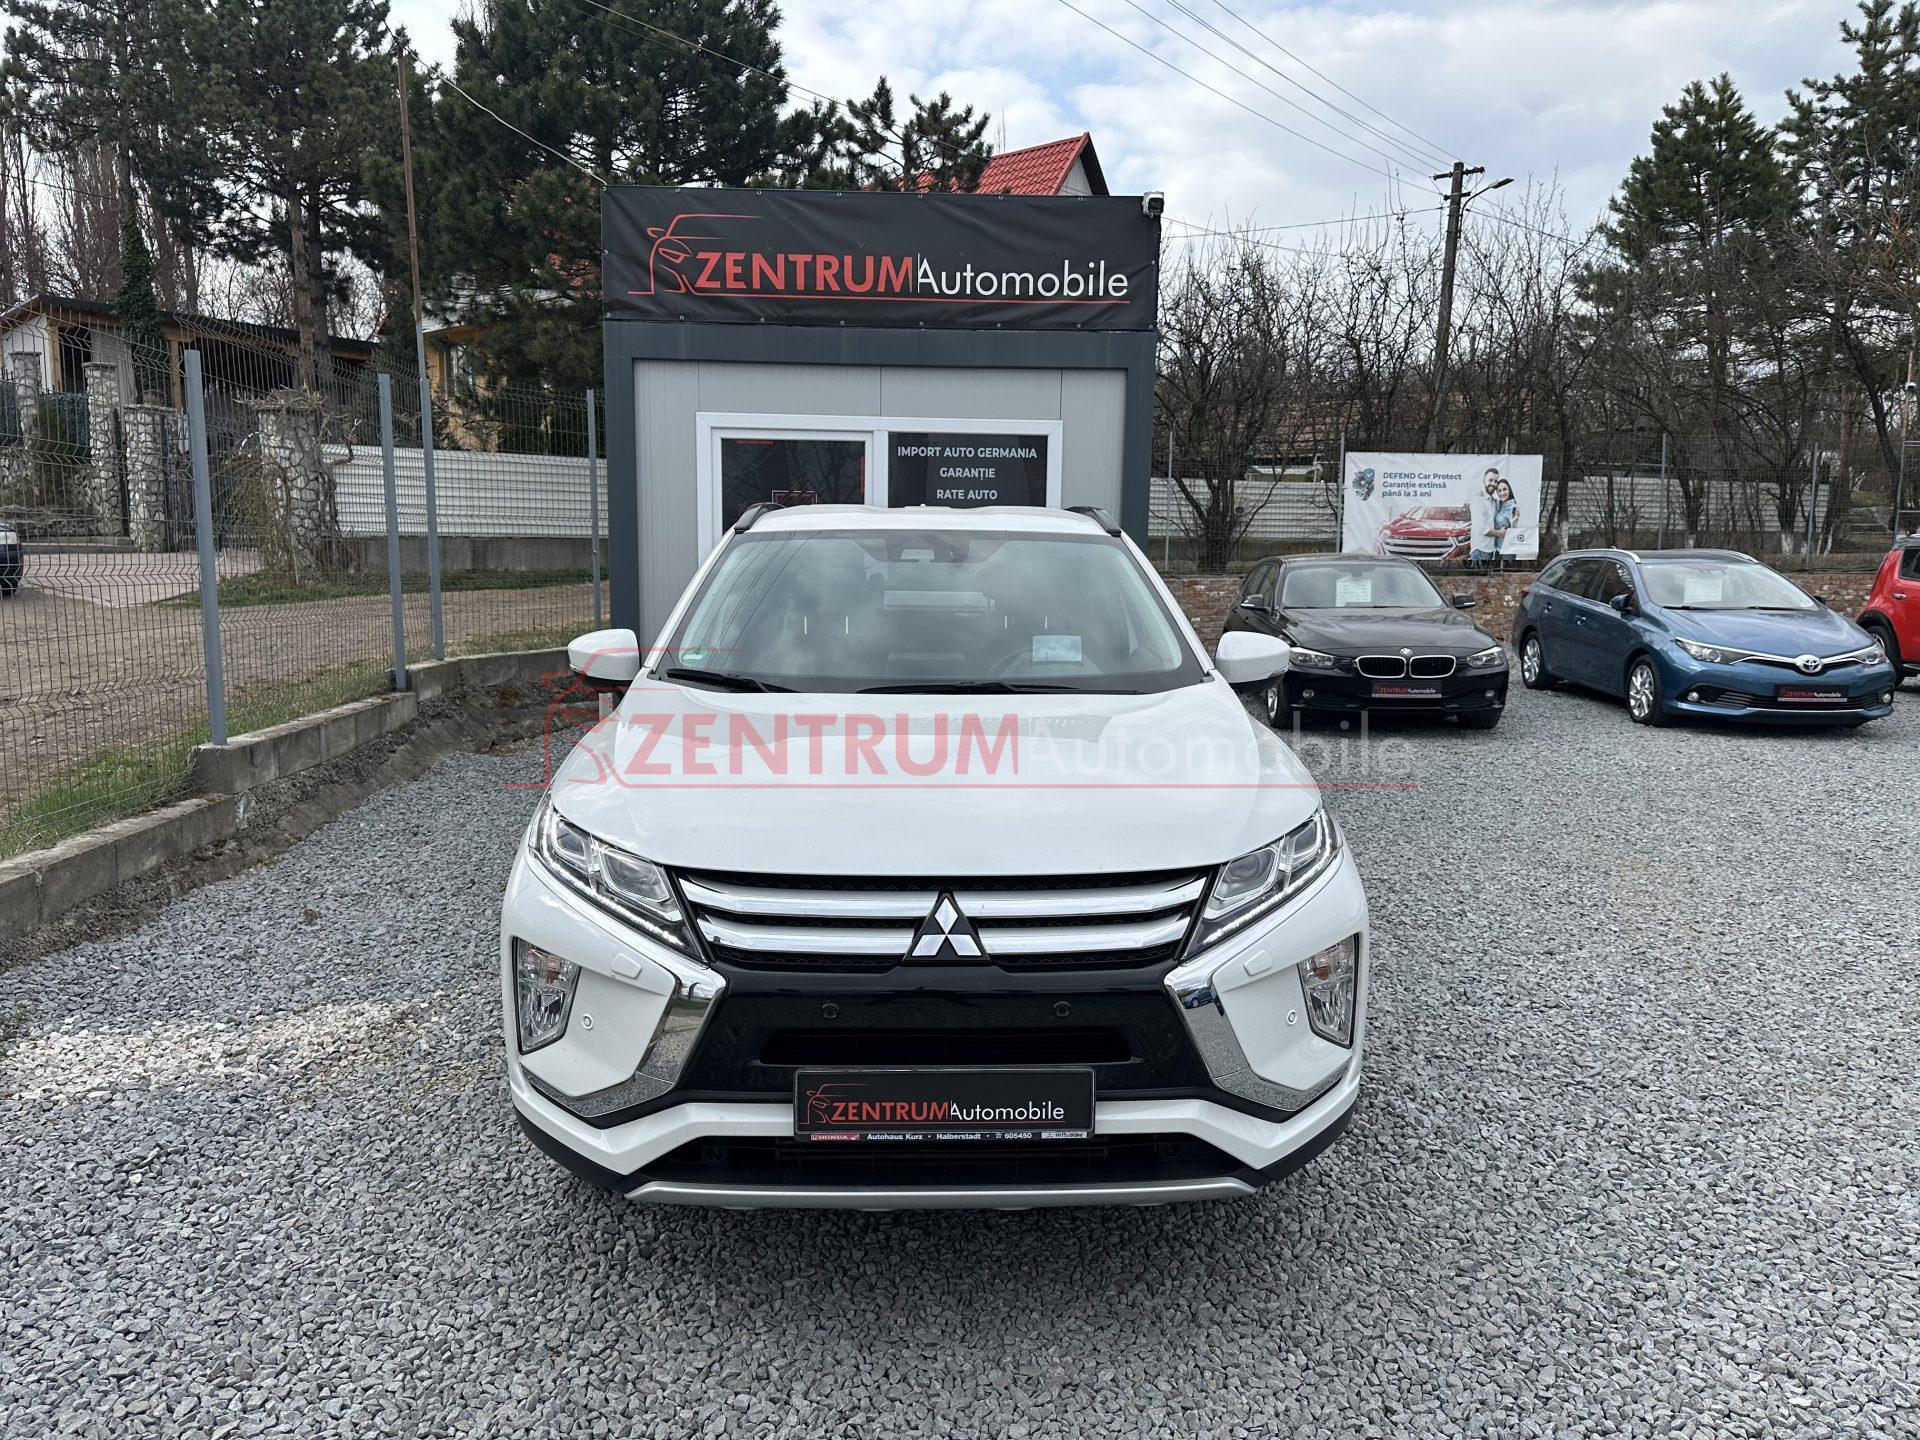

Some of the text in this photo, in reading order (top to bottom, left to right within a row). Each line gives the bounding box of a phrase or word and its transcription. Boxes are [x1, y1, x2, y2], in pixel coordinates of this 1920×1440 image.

[695, 251, 1129, 297] ZENTRUM Automobile
[897, 446, 1038, 459] IMPORT AUTO GERMANIA
[1383, 472, 1416, 480] DEFEND
[1382, 481, 1447, 490] Garanție extinsă
[936, 489, 998, 500] RATE AUTO
[832, 1100, 1064, 1121] ZENTRUM Automobile
